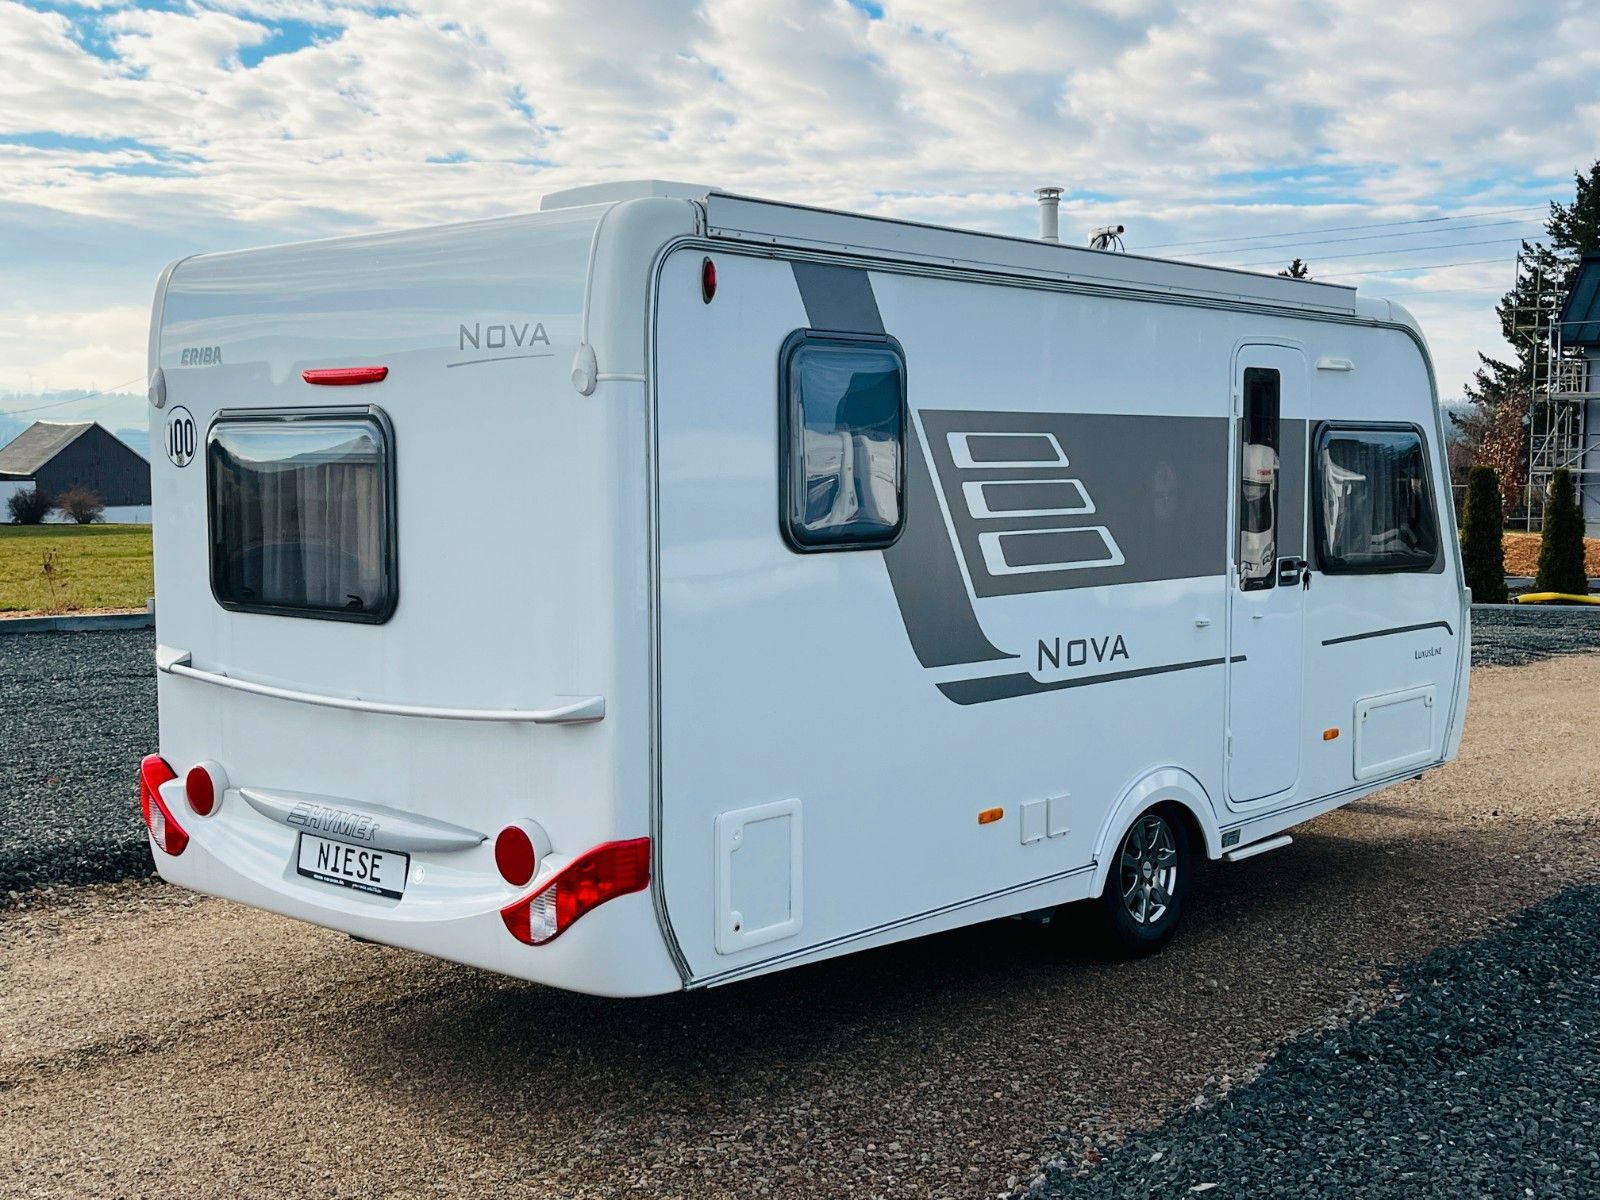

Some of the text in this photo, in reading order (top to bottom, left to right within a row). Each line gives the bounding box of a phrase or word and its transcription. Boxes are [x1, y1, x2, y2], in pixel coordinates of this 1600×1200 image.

[459, 322, 551, 351] NOVA
[181, 346, 222, 366] ERIBA
[168, 418, 194, 457] 100
[1037, 634, 1130, 671] NOVA
[304, 804, 381, 841] HYMER
[317, 841, 383, 883] NIESE
